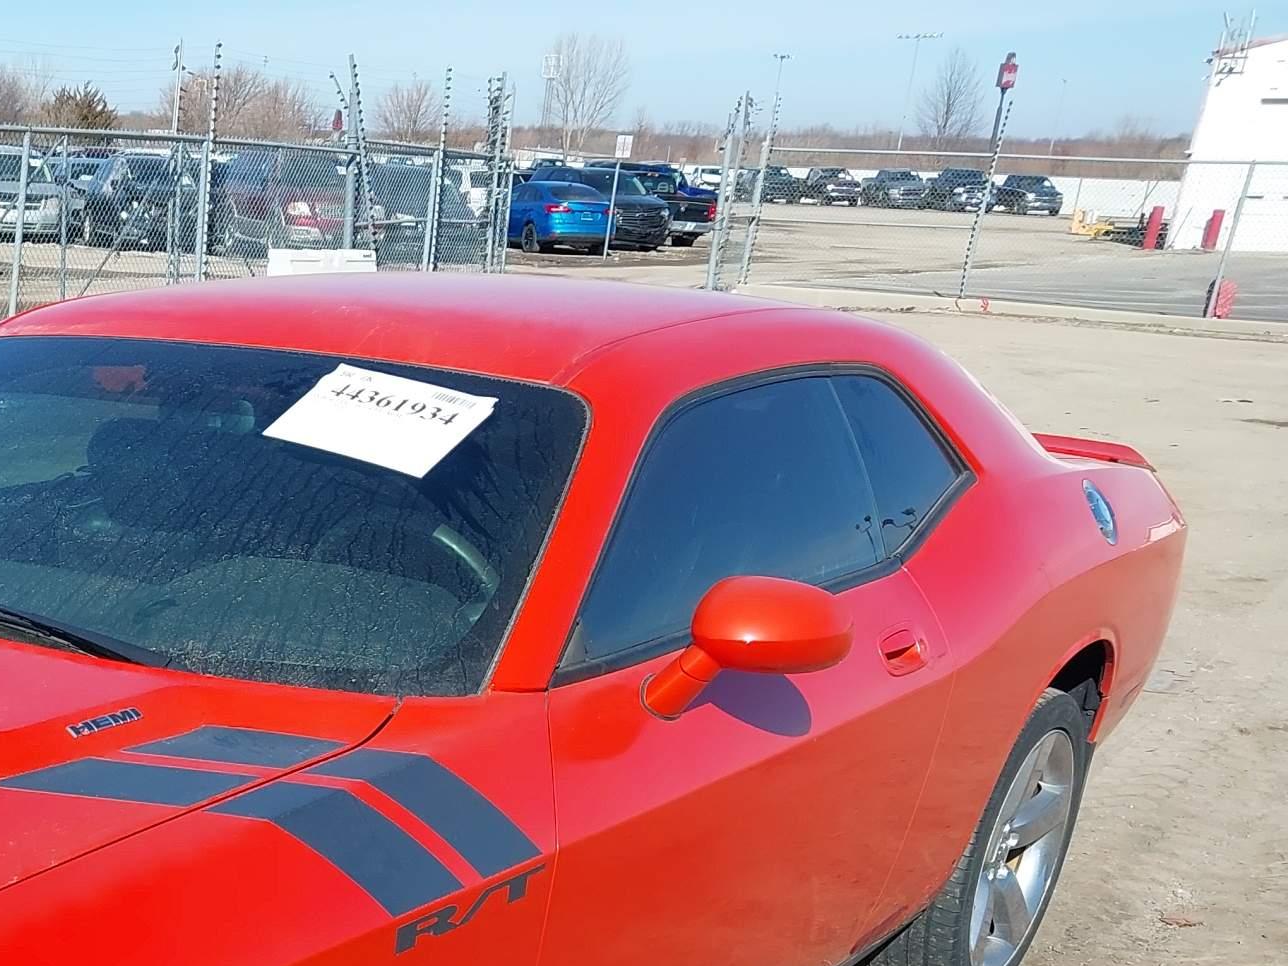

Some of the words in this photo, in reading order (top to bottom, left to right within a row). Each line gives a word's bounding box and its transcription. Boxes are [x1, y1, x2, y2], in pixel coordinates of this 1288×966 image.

[330, 384, 460, 426] 44361934
[65, 706, 144, 739] HEMI
[394, 863, 546, 957] R/T
